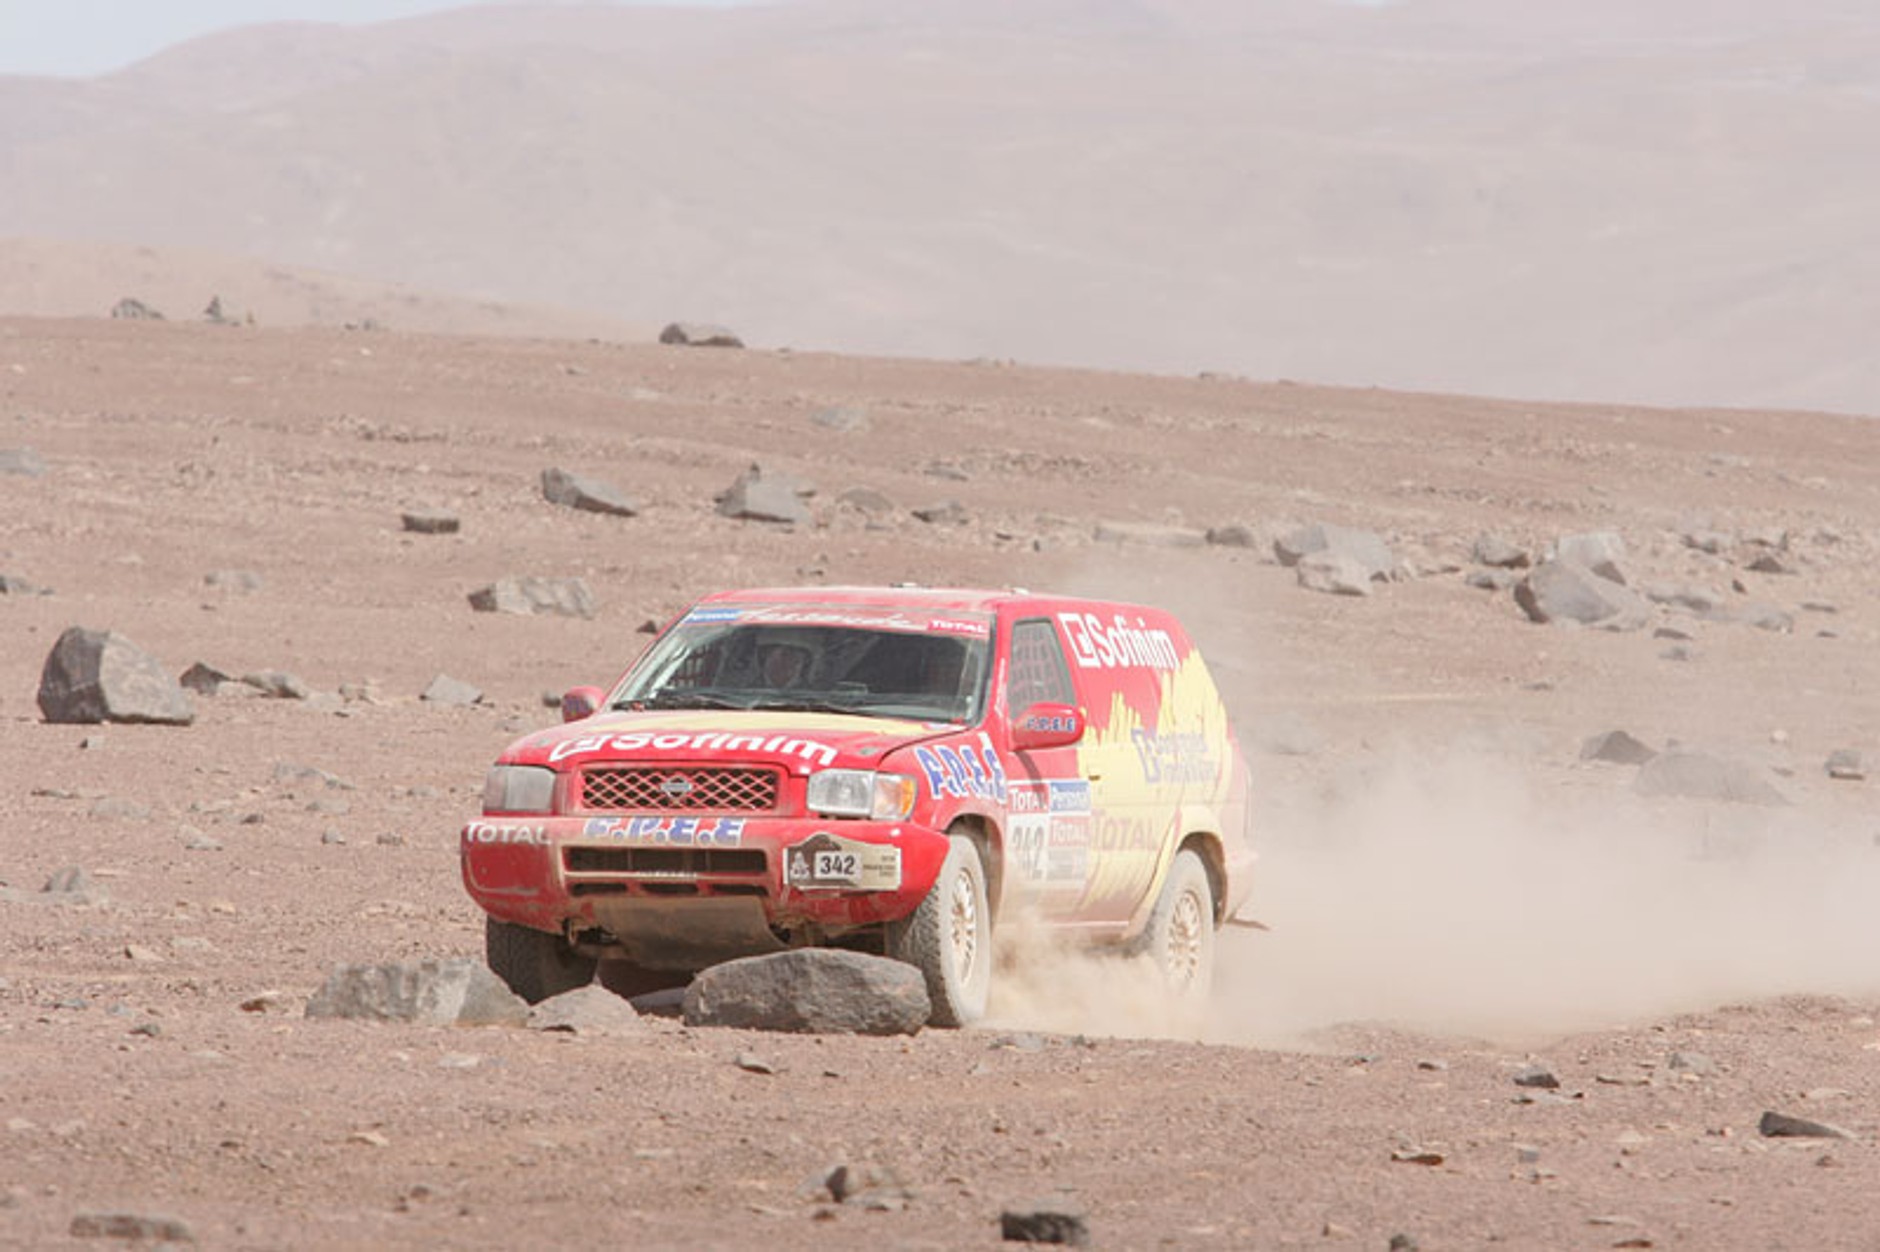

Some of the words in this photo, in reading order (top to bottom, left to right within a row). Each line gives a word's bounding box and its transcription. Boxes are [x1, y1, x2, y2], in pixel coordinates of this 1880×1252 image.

[930, 619, 987, 634] TOTAL
[1085, 613, 1180, 669] Sofinim
[611, 732, 838, 766] Sofinim
[1009, 787, 1049, 811] TOTAL
[465, 821, 552, 845] TOTAL
[820, 854, 856, 876] 342
